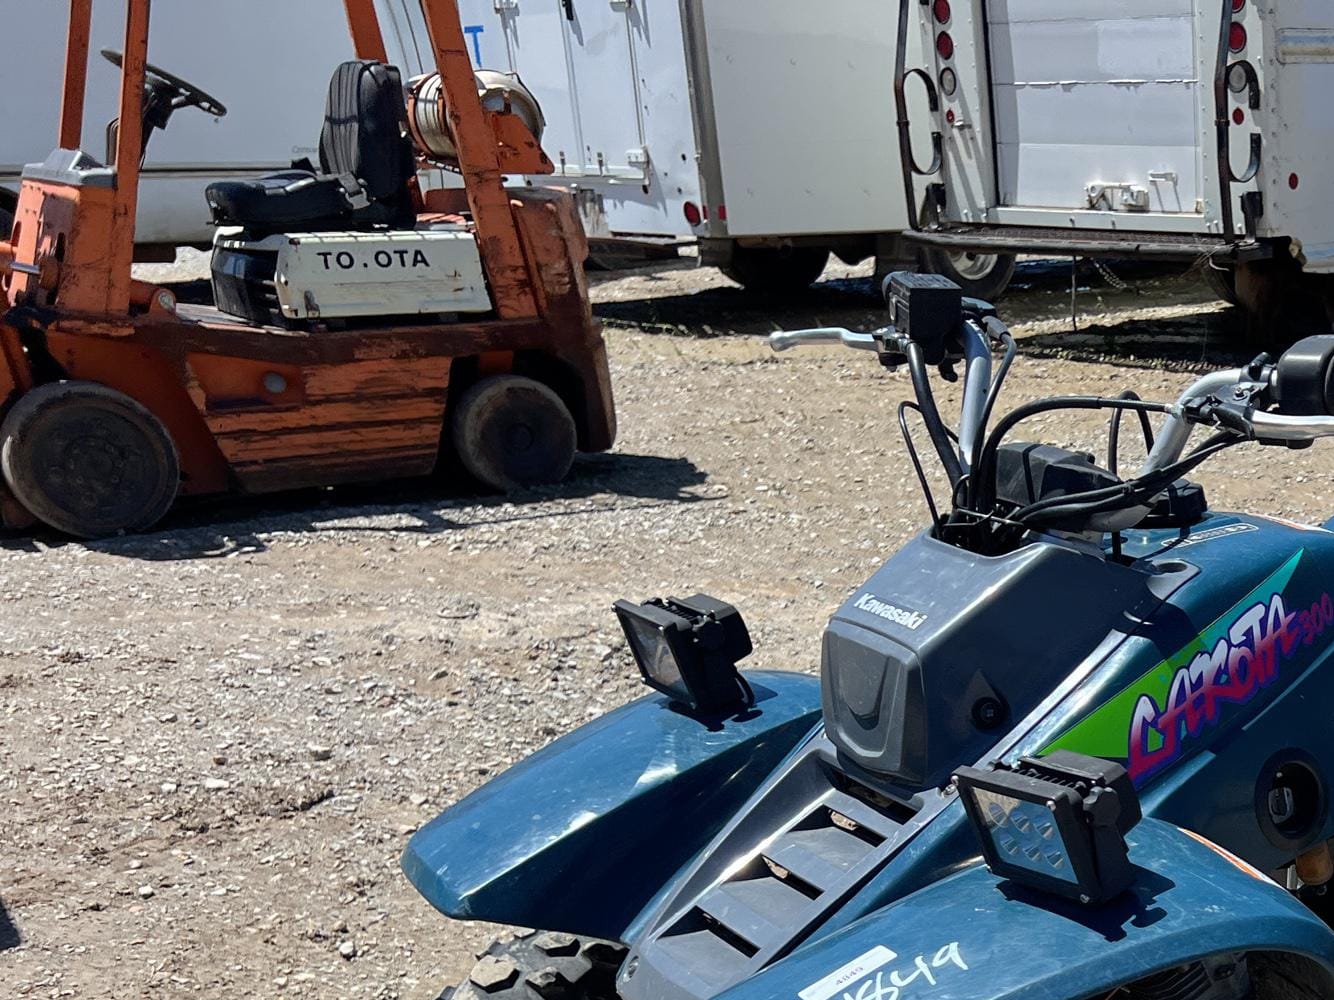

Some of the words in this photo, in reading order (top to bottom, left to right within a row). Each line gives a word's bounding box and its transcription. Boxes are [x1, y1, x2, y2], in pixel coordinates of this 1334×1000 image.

[316, 249, 431, 270] TOOTA
[853, 592, 928, 630] Kawasaki
[1128, 593, 1301, 786] LAKOTA
[1299, 591, 1334, 645] 300
